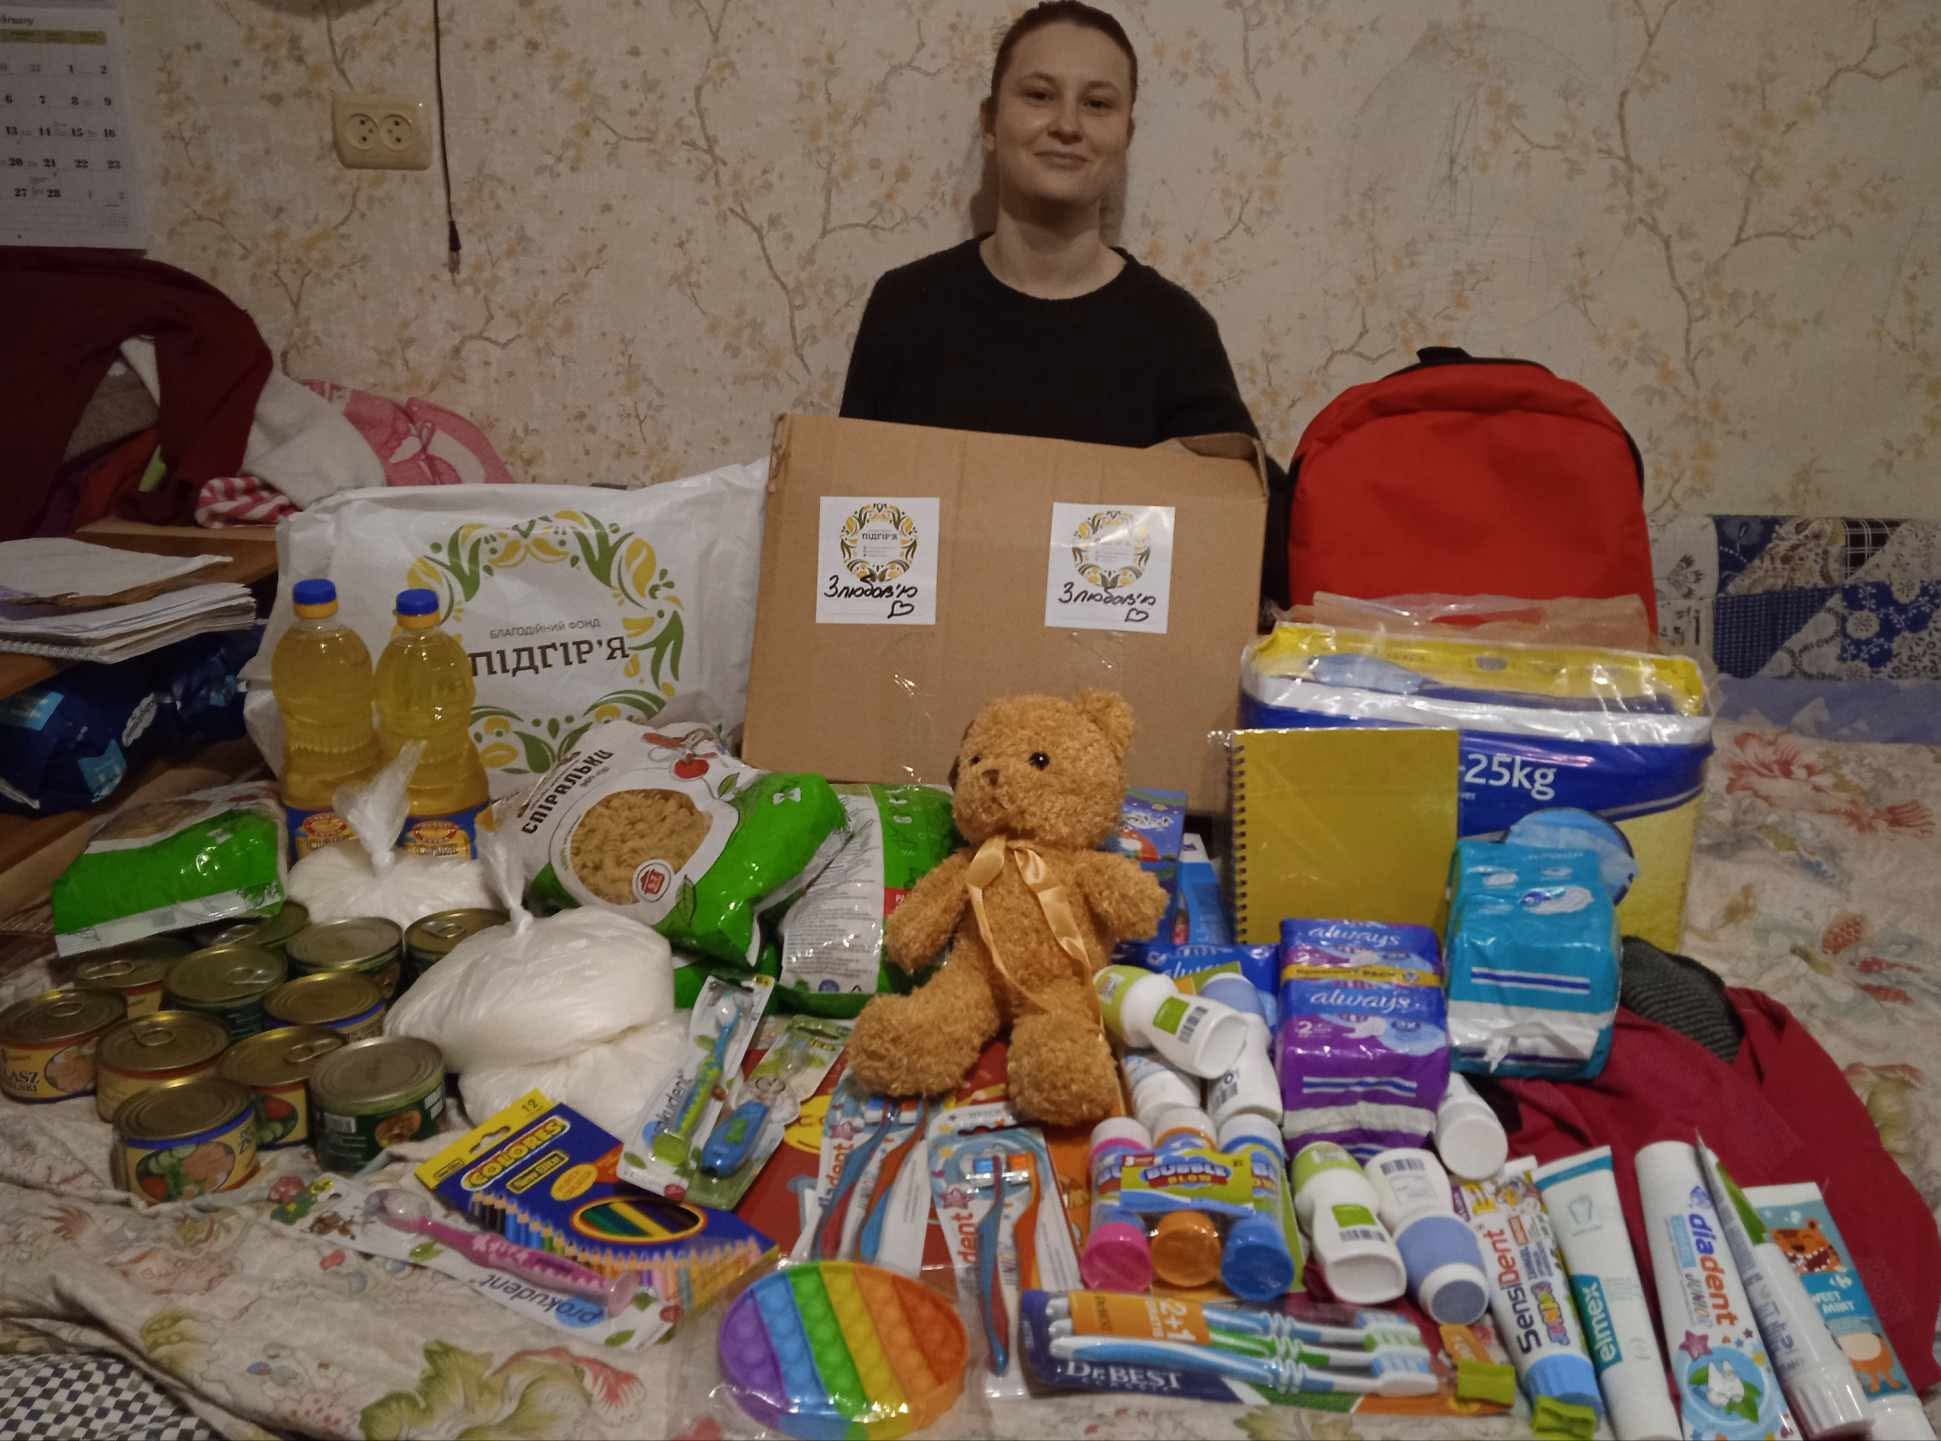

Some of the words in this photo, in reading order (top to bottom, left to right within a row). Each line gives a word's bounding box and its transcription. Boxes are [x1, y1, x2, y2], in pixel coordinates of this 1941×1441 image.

[75, 159, 89, 169] 22
[489, 620, 567, 640] БЛАГОДІЙНИЙ
[567, 617, 601, 631] ФОНД
[467, 636, 630, 678] ПІДГІР'Я
[1308, 924, 1401, 948] always
[1309, 989, 1412, 1014] always
[1688, 1213, 1739, 1327] diadent
[1582, 1281, 1617, 1363] elmex
